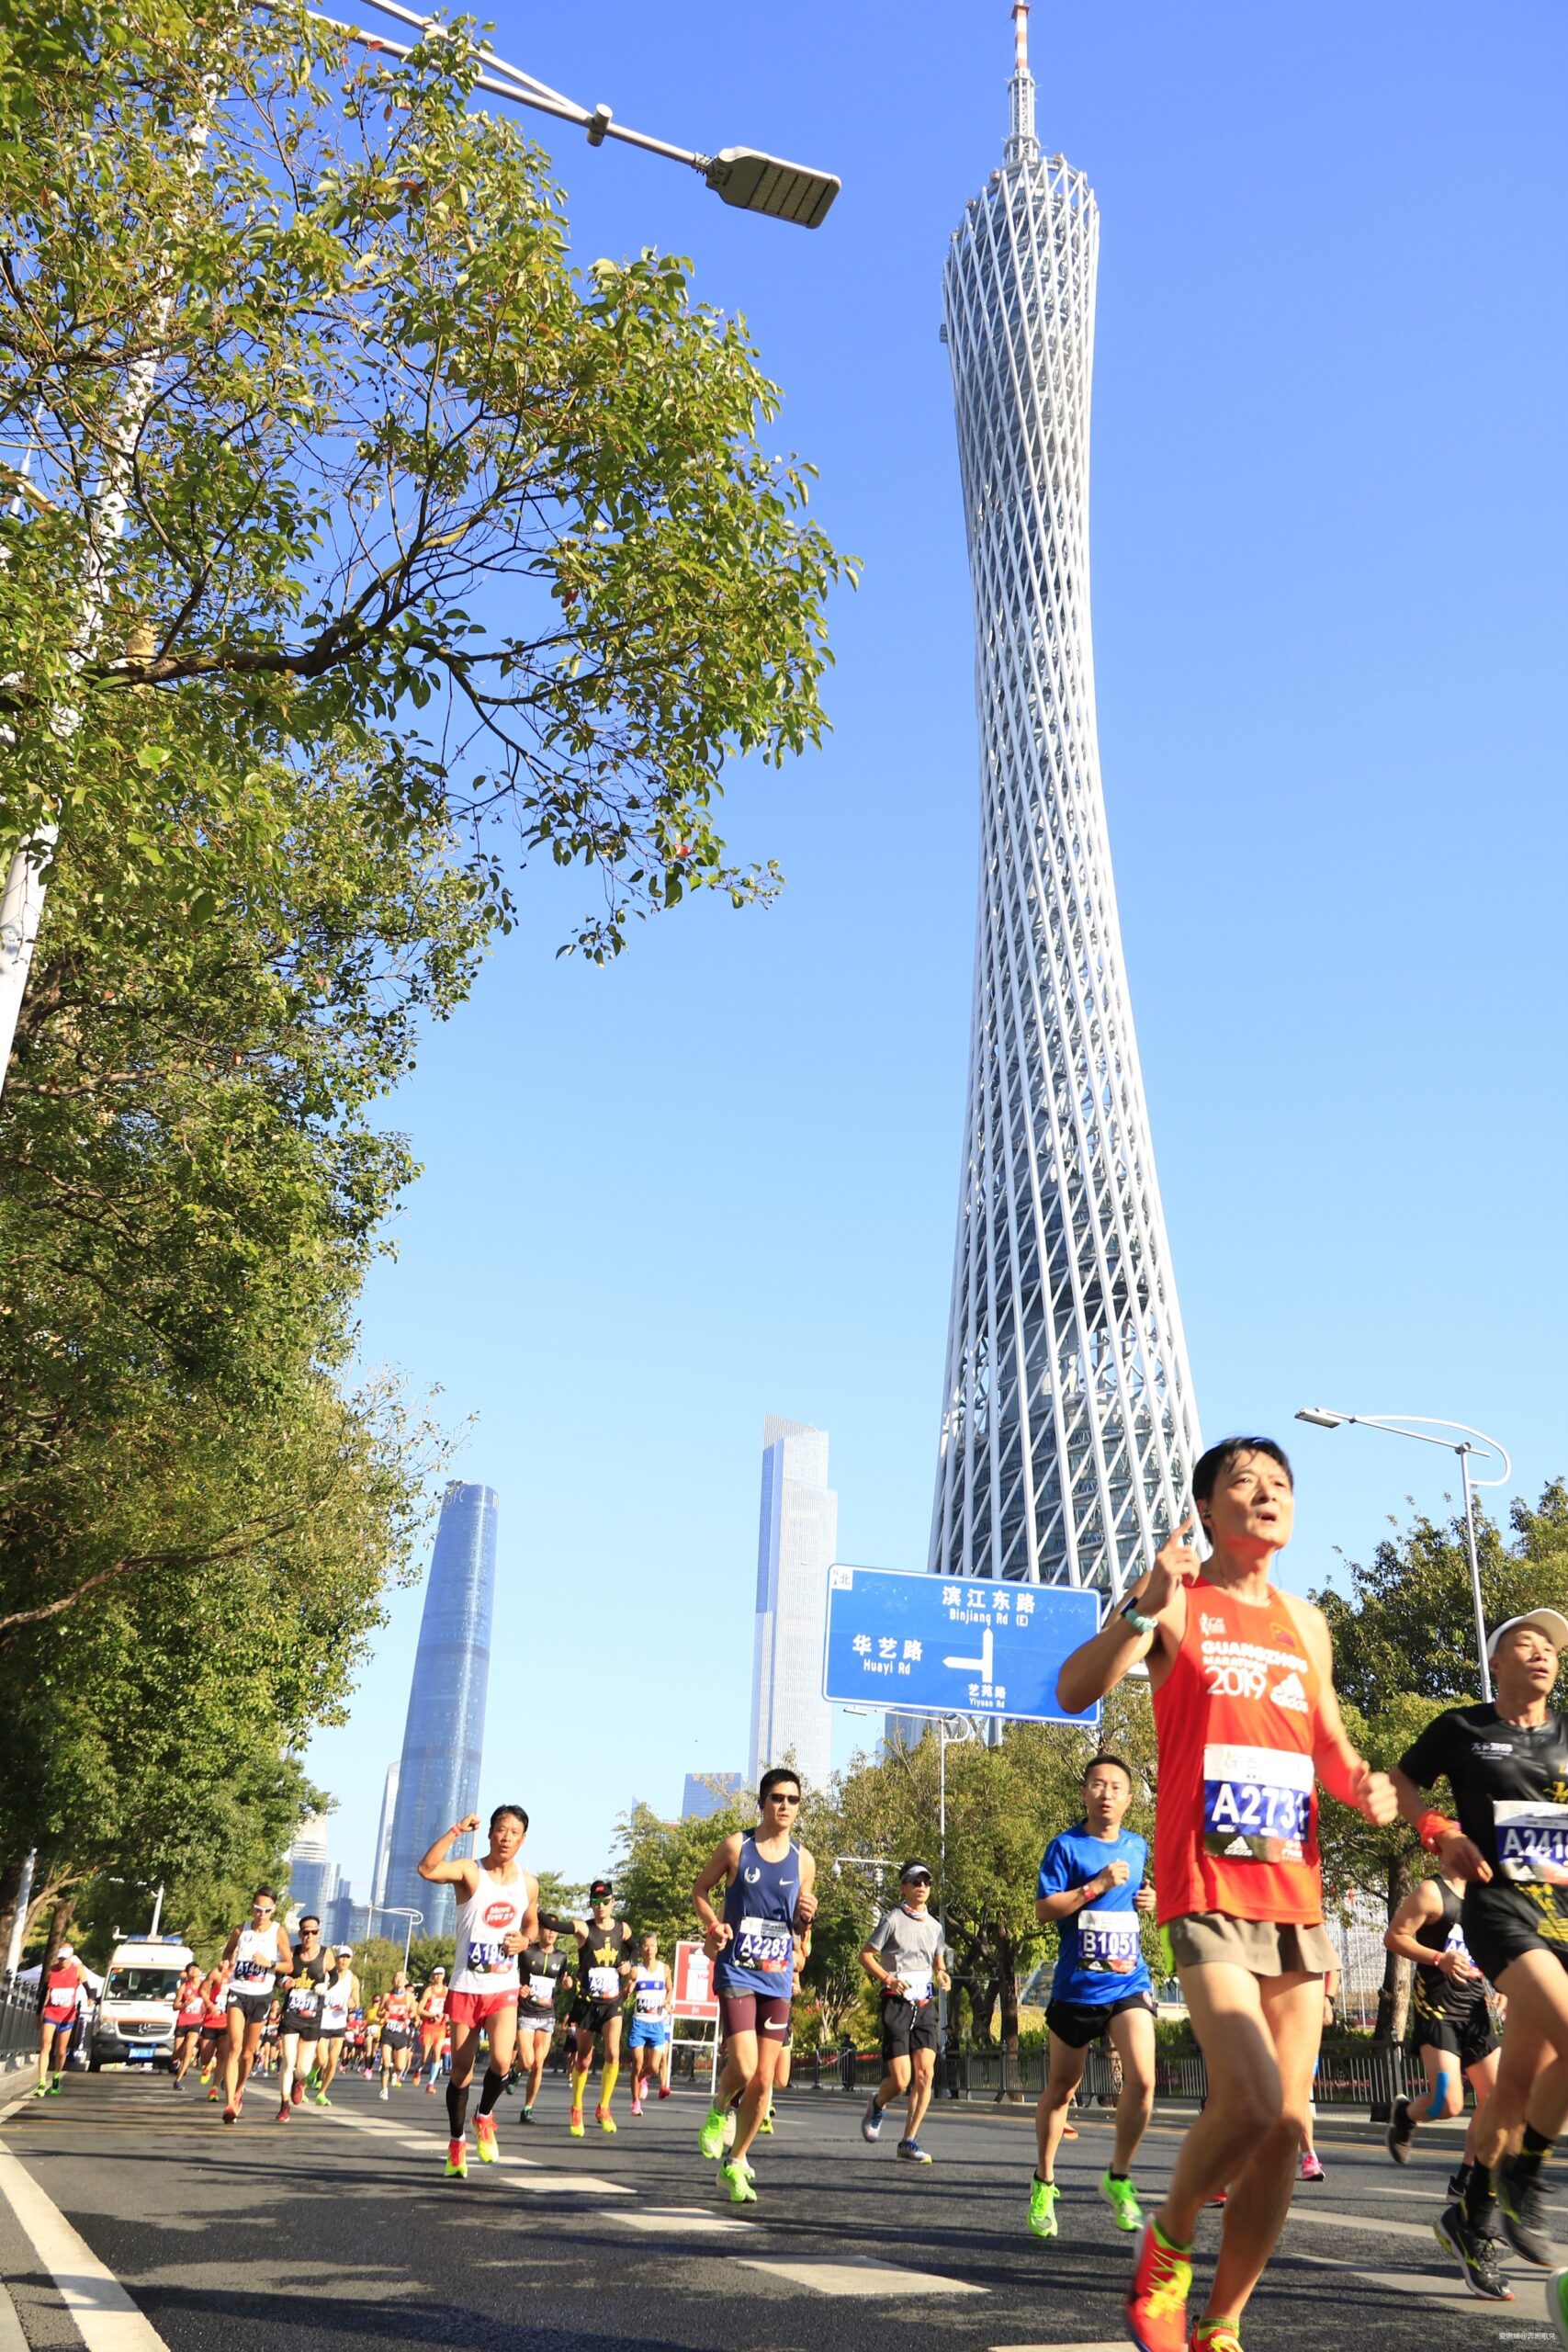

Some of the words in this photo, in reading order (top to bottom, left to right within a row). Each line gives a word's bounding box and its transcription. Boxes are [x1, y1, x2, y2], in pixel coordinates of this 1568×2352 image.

[839, 1572, 852, 1586] 北
[942, 1585, 1036, 1614] 滨江东路
[949, 1608, 991, 1627] Binjiang
[996, 1611, 1009, 1625] Rd
[1015, 1614, 1029, 1627] (E)
[852, 1634, 923, 1662] 华艺路
[863, 1657, 894, 1676] Huayi
[897, 1661, 911, 1676] Rd
[968, 1683, 1007, 1700] 艺苑路
[1204, 1666, 1268, 1701] 2019
[969, 1697, 994, 1709] Yiyuan
[996, 1699, 1005, 1709] Rd
[739, 1934, 788, 1957] A2283
[1083, 1930, 1137, 1956] B1051
